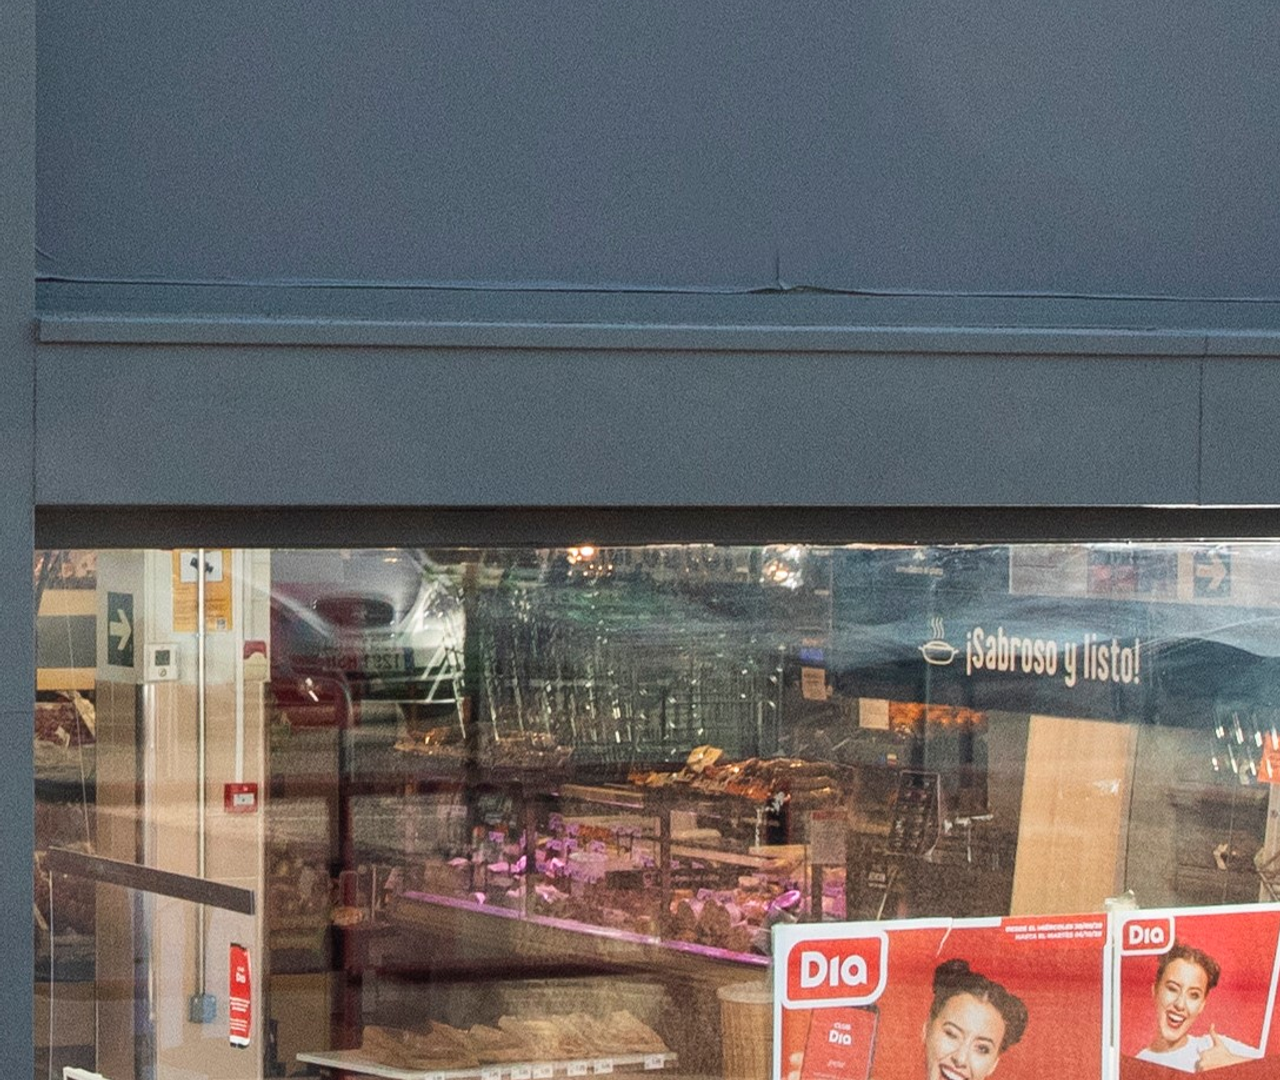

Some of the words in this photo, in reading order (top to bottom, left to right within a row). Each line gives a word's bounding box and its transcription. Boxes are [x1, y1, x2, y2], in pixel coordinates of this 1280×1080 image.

[966, 626, 1057, 676] ¡Sabroso
[1064, 642, 1077, 687] y
[1084, 633, 1140, 684] listo!
